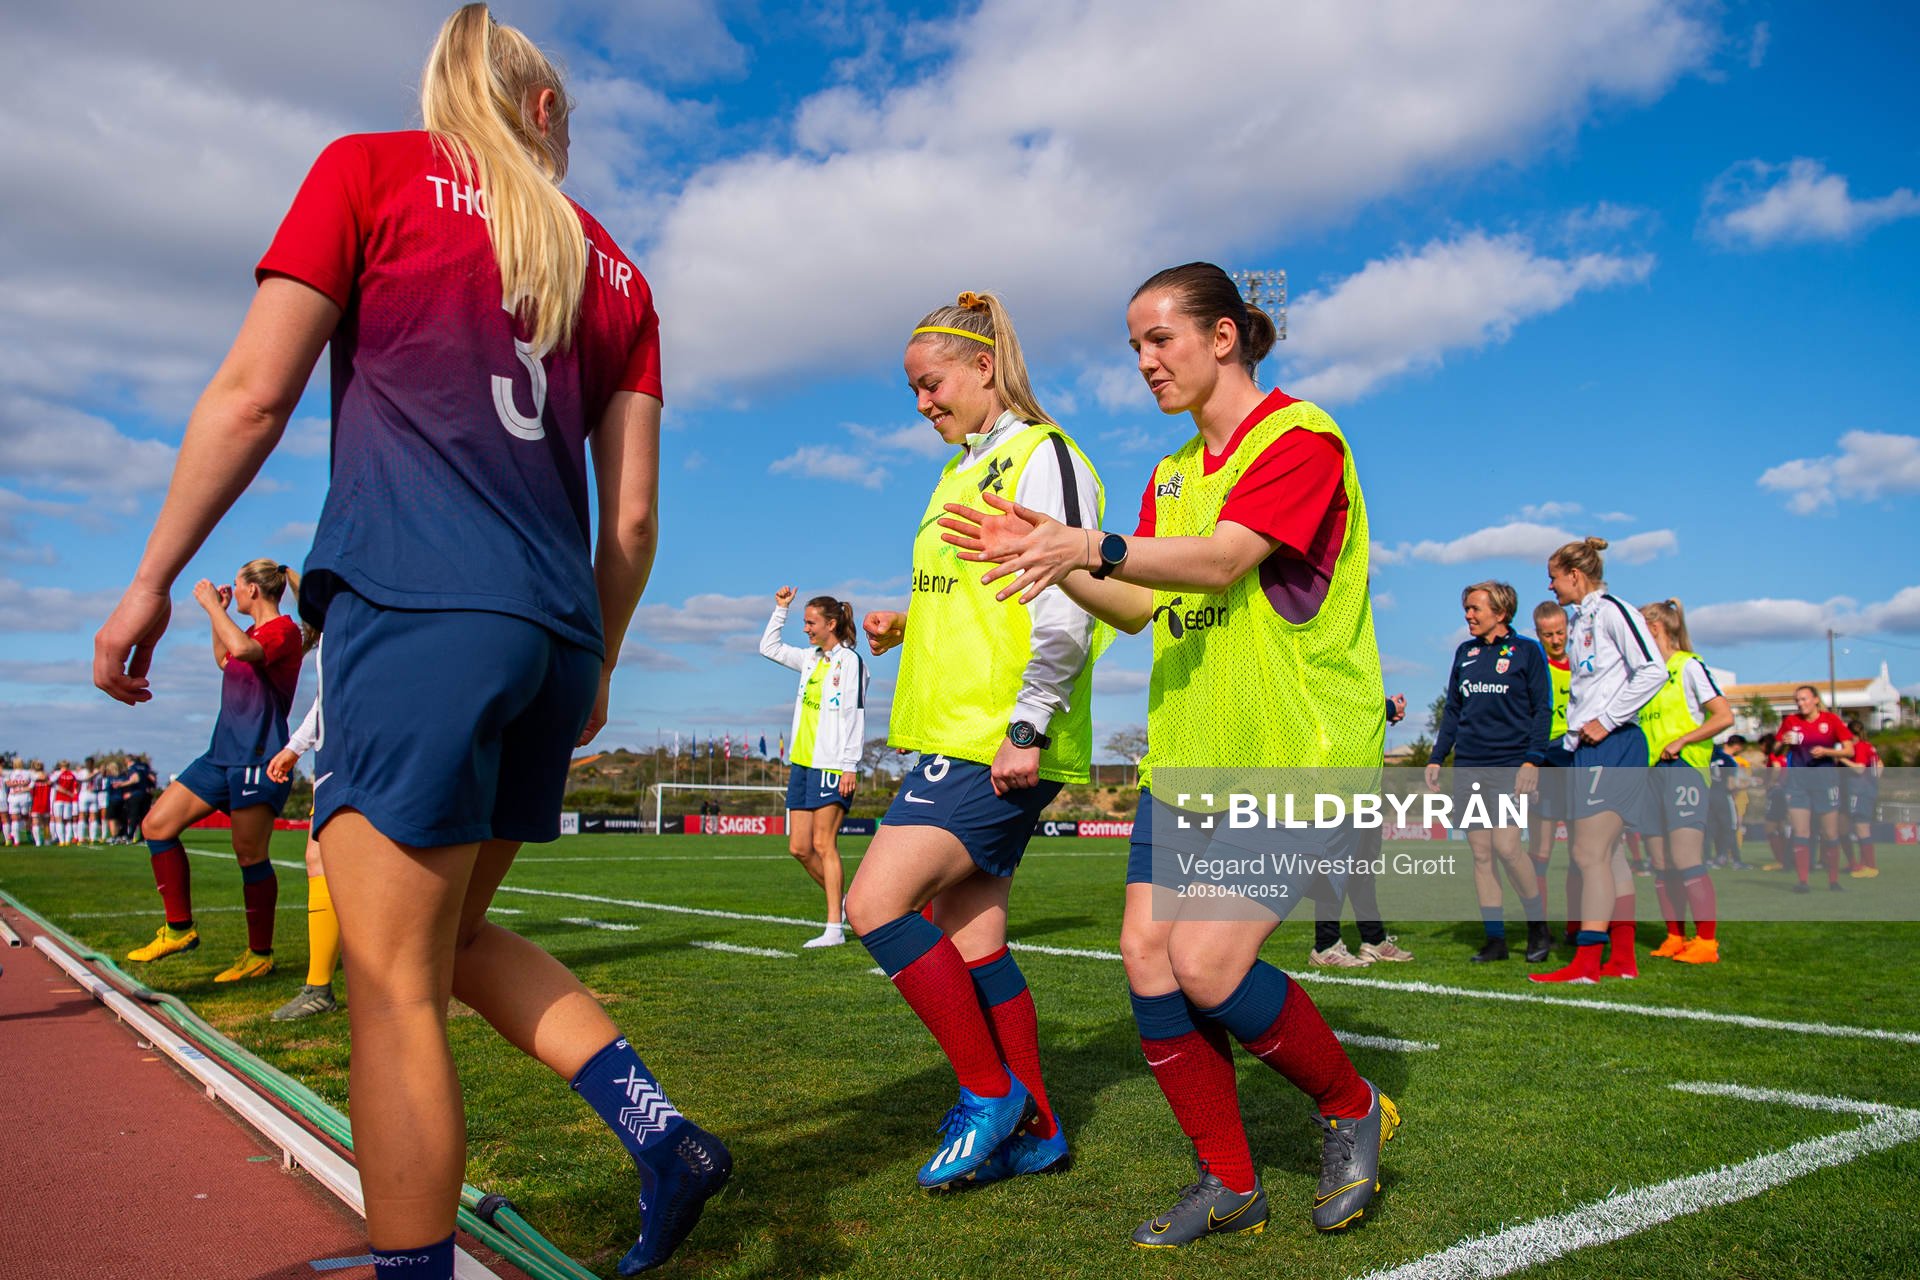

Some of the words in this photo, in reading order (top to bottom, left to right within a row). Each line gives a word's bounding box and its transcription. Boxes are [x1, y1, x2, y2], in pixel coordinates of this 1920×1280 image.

[244, 766, 261, 784] 11
[820, 769, 840, 789] 10
[1588, 765, 1603, 794] 7
[1675, 786, 1700, 806] 20
[719, 816, 767, 834] SAGRES
